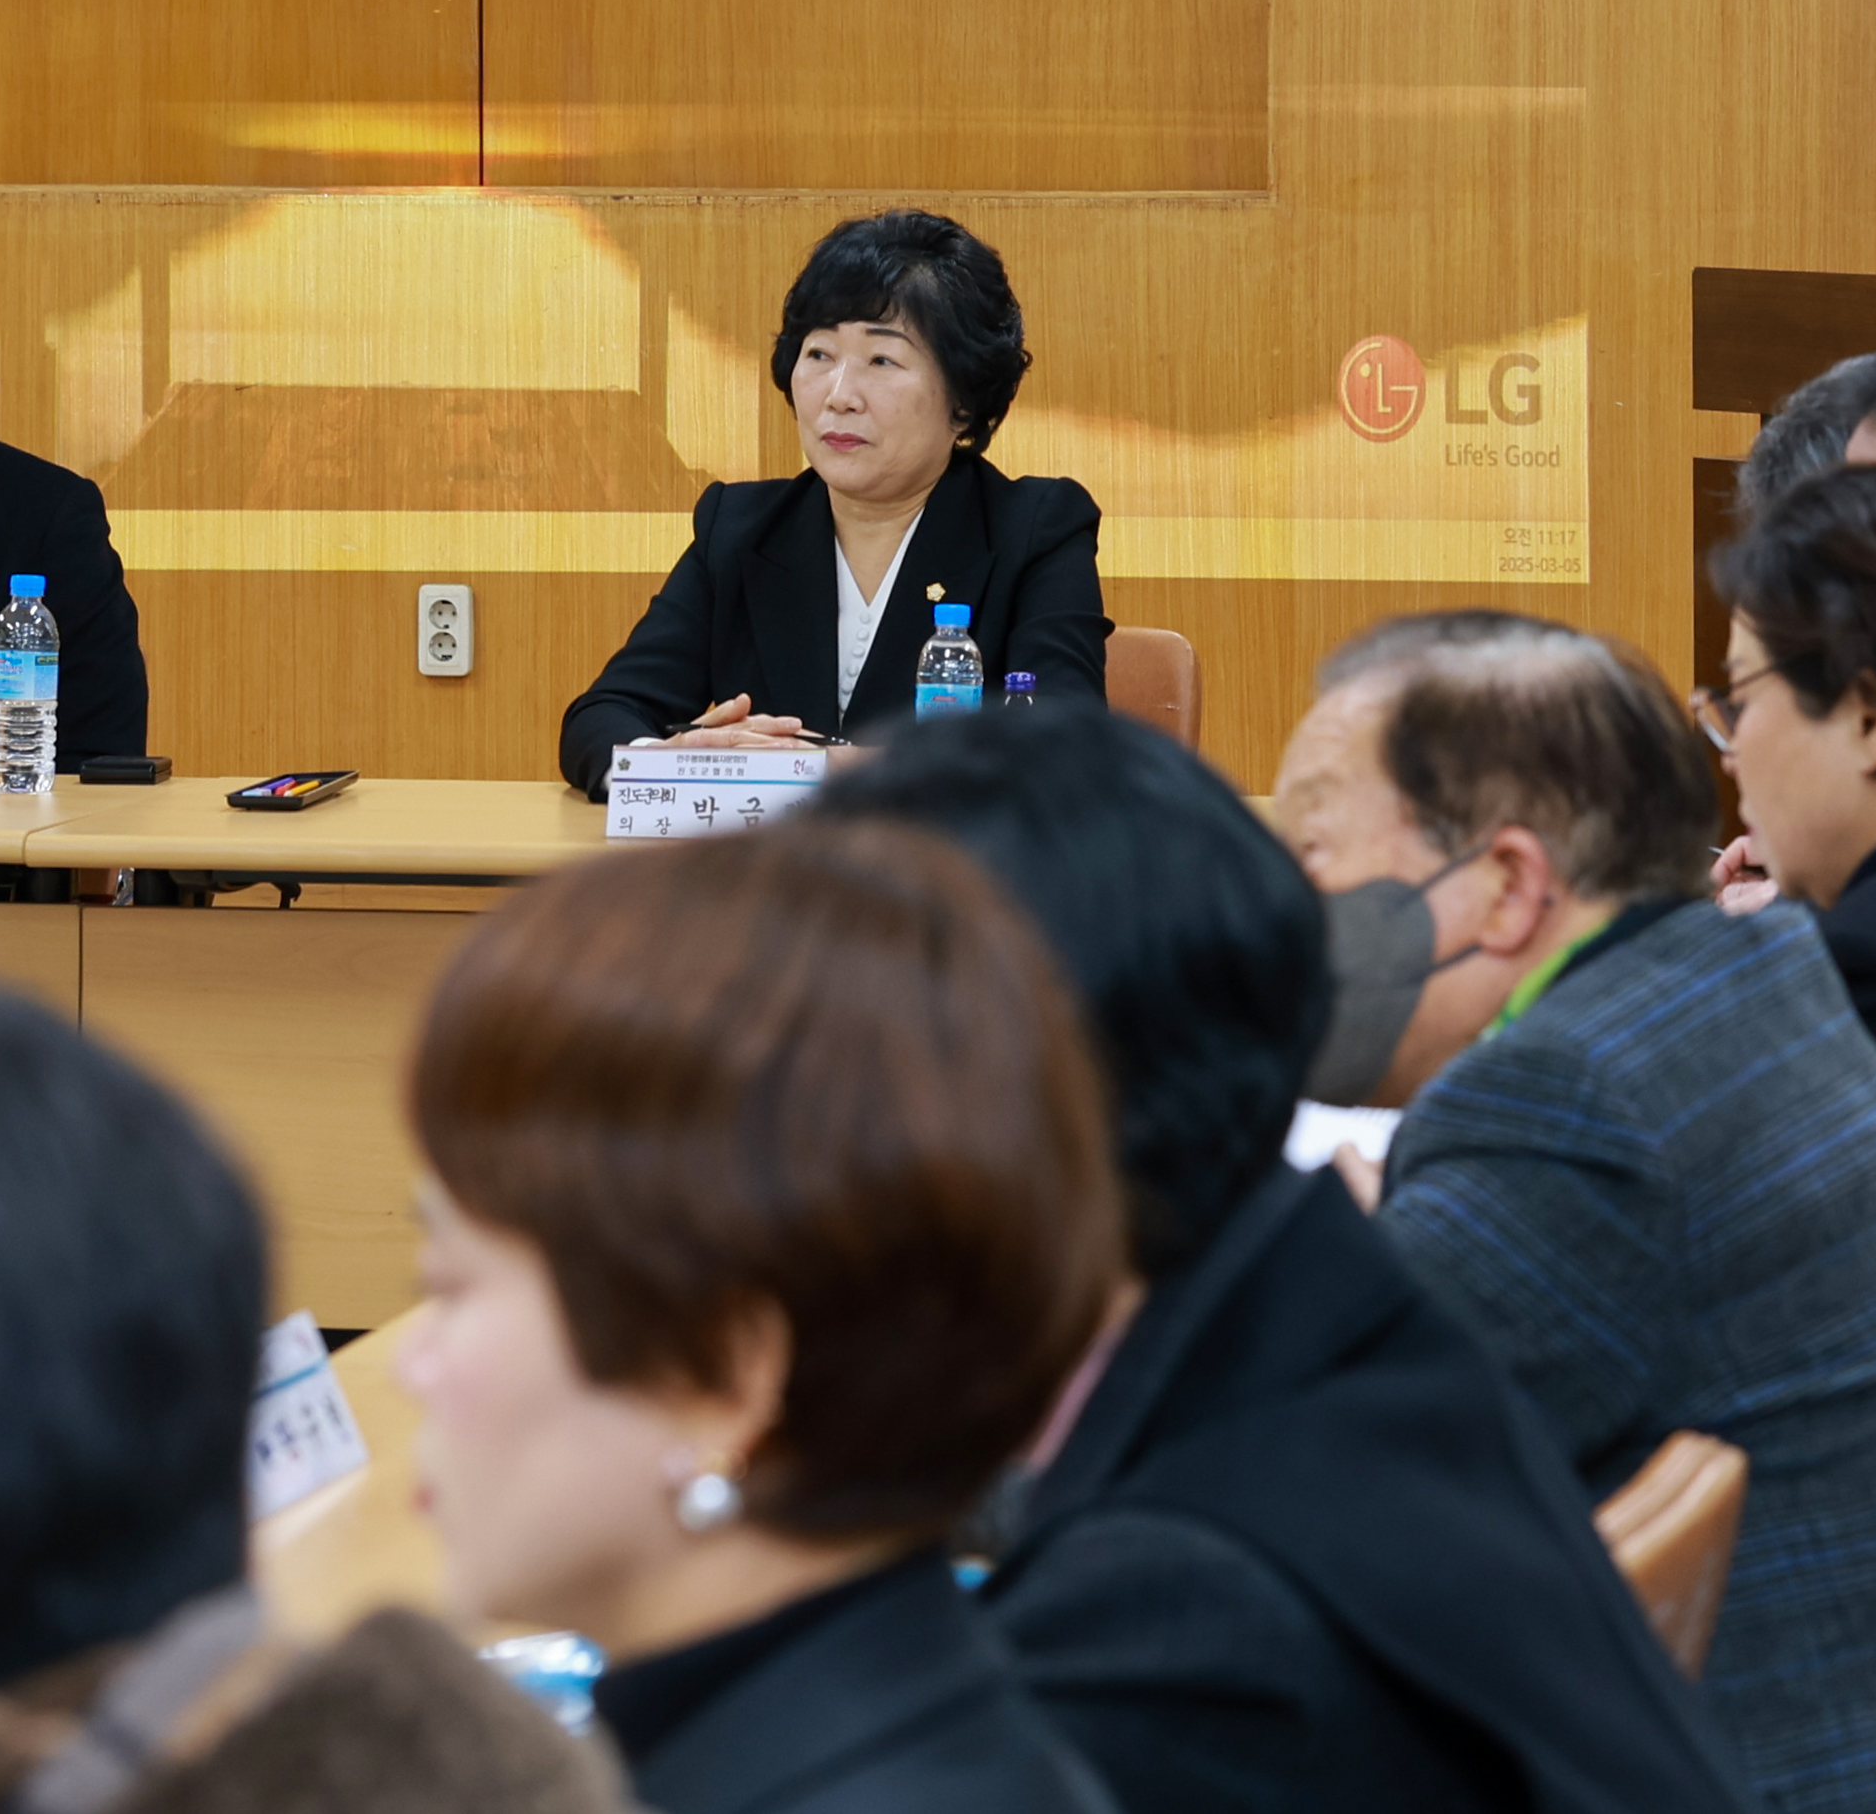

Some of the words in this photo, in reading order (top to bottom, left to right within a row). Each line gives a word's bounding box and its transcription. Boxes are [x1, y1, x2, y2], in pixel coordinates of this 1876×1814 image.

[1444, 351, 1542, 426] LG
[1445, 443, 1499, 467] Life's
[1505, 444, 1561, 468] Good
[1503, 527, 1533, 548] 오전
[1498, 556, 1582, 573] 2025-03-05
[617, 786, 677, 805] 진도군의회
